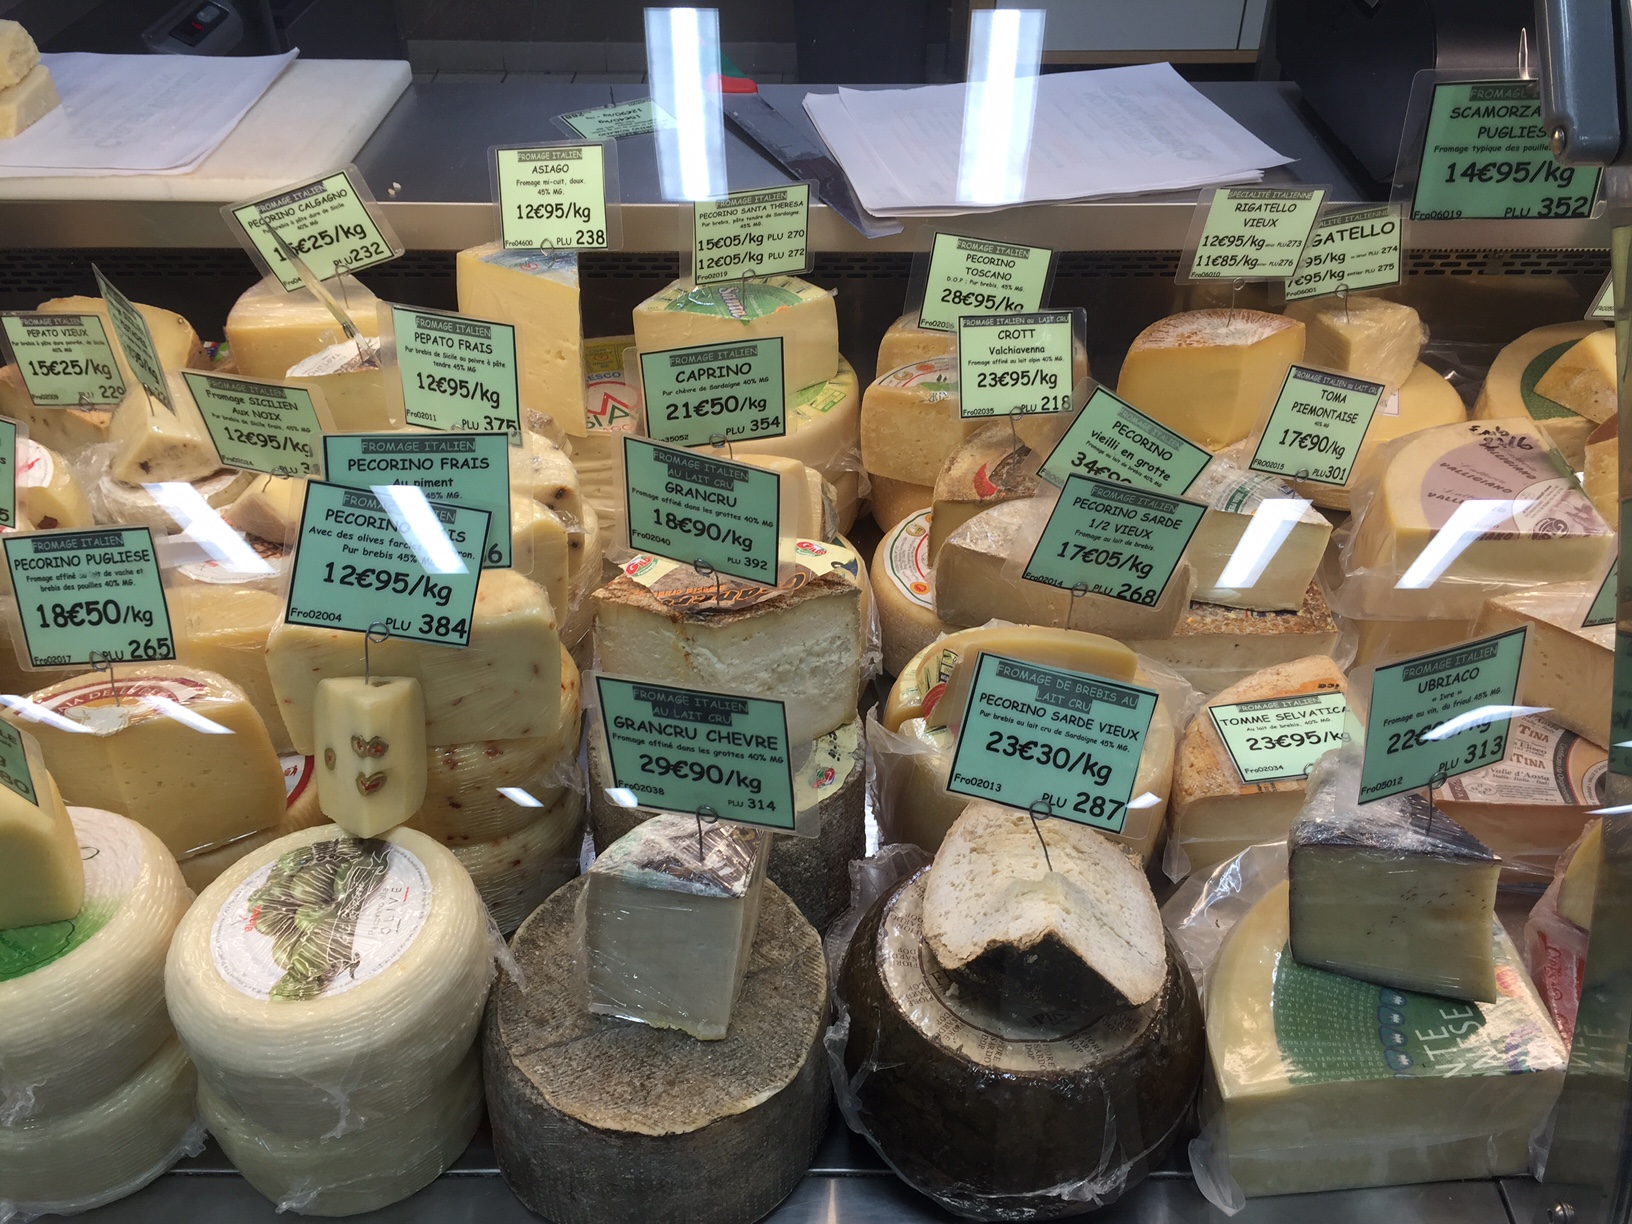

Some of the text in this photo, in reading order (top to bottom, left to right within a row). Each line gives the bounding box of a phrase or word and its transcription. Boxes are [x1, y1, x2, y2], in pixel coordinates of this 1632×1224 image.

[1477, 124, 1553, 138] PUGLIES
[531, 163, 569, 174] ASIAGO
[1445, 159, 1578, 188] 14€95/kg
[516, 179, 540, 187] Fromage
[298, 189, 347, 212] CALGAGNO
[699, 200, 803, 219] PECORINO SANTA THERESA
[1234, 202, 1297, 212] RIGATELLO
[1412, 196, 1588, 219] Fro06019 PLU 352
[517, 202, 590, 223] 12€95/kg
[1244, 218, 1279, 227] VIEUX
[556, 237, 572, 246] PLU
[576, 229, 605, 245] 238
[698, 229, 804, 251] 15€05/kg PLU 270
[1202, 235, 1265, 250] 12€95/kg
[698, 248, 804, 270] 12€05/kg PLU 272
[966, 253, 1015, 268] PECORINO
[1196, 254, 1258, 269] 11€85/kg
[965, 266, 1012, 281] TOSCANO
[26, 329, 58, 337] PEPATO
[414, 331, 492, 354] PEPATO FRAIS
[997, 328, 1035, 340] CROTT
[988, 345, 1045, 355] Valchiavenna
[28, 358, 112, 379] 15€25/kg
[433, 360, 451, 368] tendre
[453, 363, 465, 371] 45%
[675, 362, 751, 383] CAPRINO
[587, 371, 621, 382] ESCO
[977, 369, 1057, 389] 23€95/kg
[205, 389, 298, 410] Fromage SICILIEN
[416, 372, 499, 409] 12€95/kg
[1321, 389, 1347, 403] TOMA
[232, 407, 282, 421] Aux NOIX
[666, 395, 766, 420] 21€50/kg
[1291, 401, 1359, 424] PIEMONTAISE
[725, 415, 780, 435] PLU 354
[362, 440, 476, 453] FROMAGE ITALIEN
[1112, 420, 1172, 460] PECORINO
[1278, 428, 1345, 460] 17€90/kg
[348, 457, 489, 471] PECORINO FRAIS
[653, 449, 748, 482] FROMAGE ITALIEN
[1091, 430, 1170, 481] vieilli en grotte
[1439, 461, 1513, 495] VALLIGIANO
[665, 481, 737, 507] GRANCRU
[324, 507, 412, 535] PECORINO
[1072, 496, 1183, 529] PECORINO SARDE
[308, 526, 332, 536] Avec
[336, 530, 353, 540] des
[357, 533, 384, 545] olives
[653, 508, 752, 552] 18€90/kg
[1088, 518, 1153, 539] 1/2 VIEUX
[14, 549, 150, 570] PECORINO PUGLIESE
[342, 544, 417, 563] Pur brebis 45%
[631, 529, 767, 570] Fro02040 PLU 392
[1057, 541, 1153, 579] 17€05/kg
[323, 561, 452, 606] 12€95/kg
[36, 599, 153, 628] 18€50/kg
[290, 607, 467, 639] Fro02004 PLU 384
[102, 650, 125, 662] PLU
[128, 637, 173, 660] 265
[1418, 667, 1479, 694] UBRIACO
[1439, 692, 1454, 701] Ivre
[979, 692, 1139, 741] PECORINO SARDE VIEUX
[1219, 714, 1270, 726] TOMME
[613, 715, 778, 750] GRANCRU CHEVRE
[979, 709, 991, 717] Pur
[992, 713, 1014, 723] brebis
[1026, 721, 1038, 729] lait
[1064, 731, 1097, 744] Sardaigne
[1100, 739, 1114, 748] 45%
[1116, 743, 1129, 752] MG.
[1517, 724, 1549, 744] TINA
[612, 732, 783, 763] Fromage affiné dans les grottes 40% MG
[985, 731, 1112, 786] 23€30/kg
[1360, 735, 1503, 795] Fro05012 PLU 313
[639, 754, 761, 794] 29€90/kg
[1244, 765, 1284, 774] Fro02034
[727, 799, 743, 807] PLU
[747, 798, 776, 811] 314
[953, 773, 1125, 820] Fro02013 PLU 287
